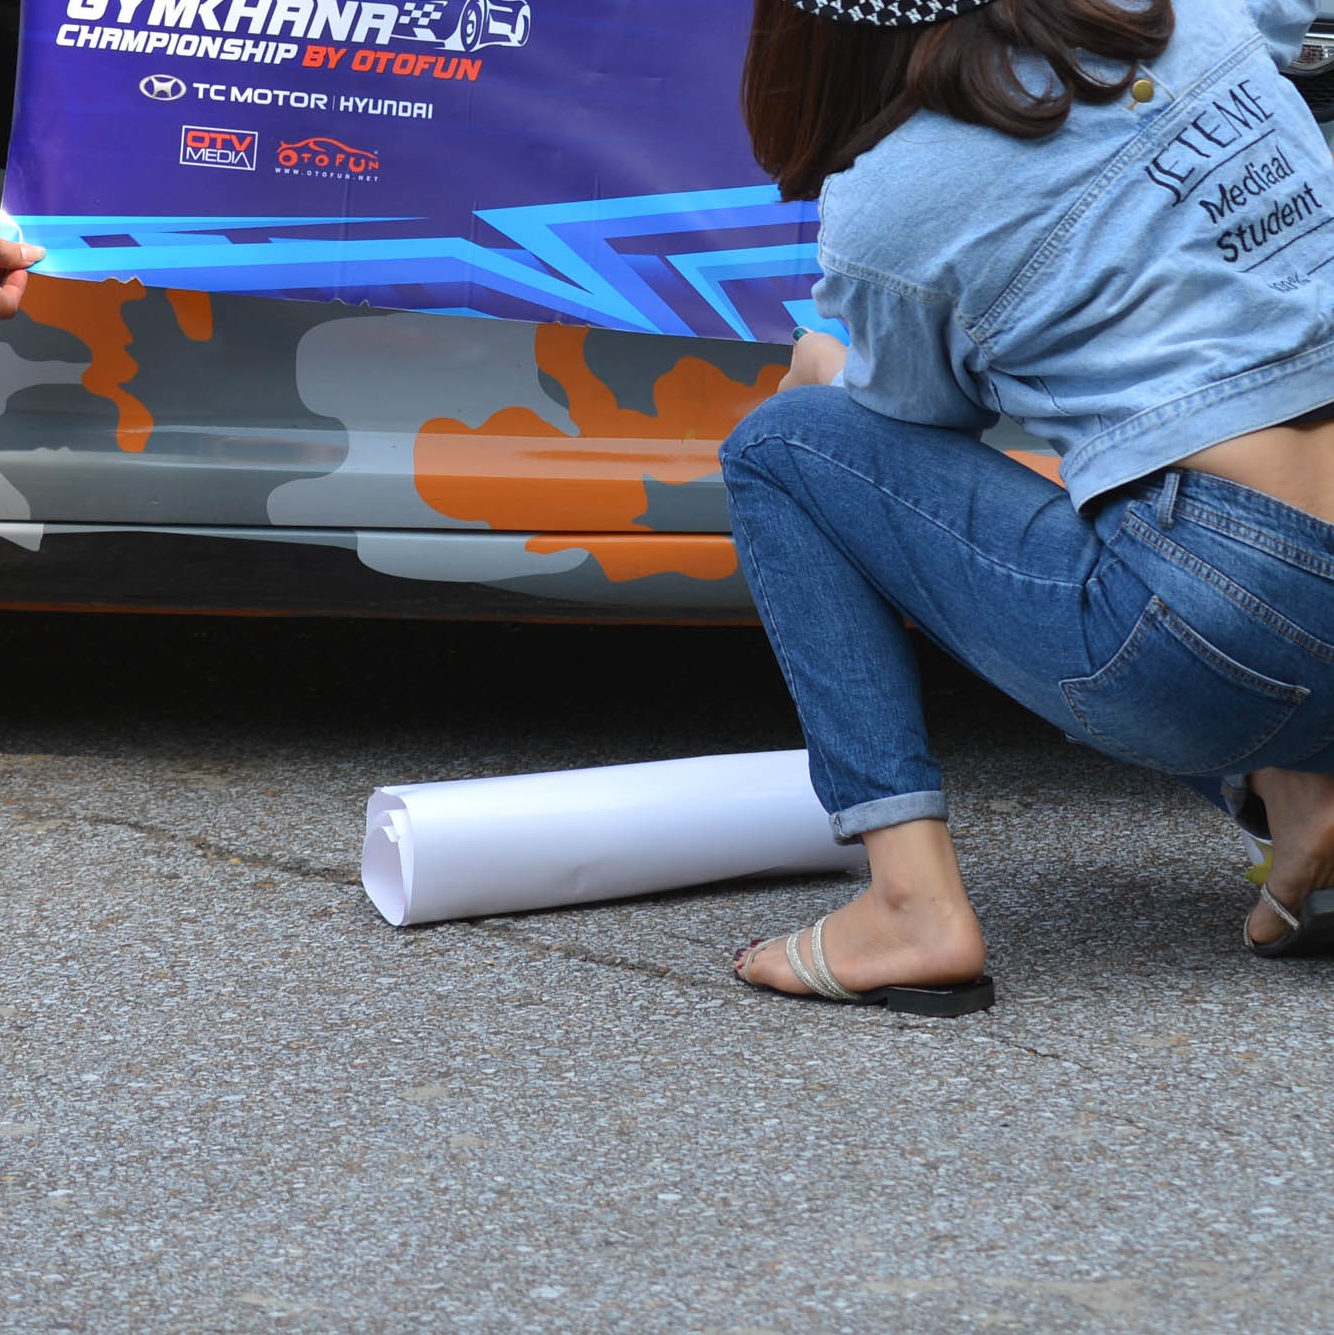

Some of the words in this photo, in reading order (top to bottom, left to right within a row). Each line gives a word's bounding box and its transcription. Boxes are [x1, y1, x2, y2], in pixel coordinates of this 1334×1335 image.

[56, 23, 298, 65] CHAMPIONSHIP
[302, 45, 347, 69] BY
[351, 49, 483, 82] OTOFUN
[193, 82, 226, 102] TC
[230, 86, 327, 110] MOTOR
[339, 96, 434, 119] HYUNDAI
[186, 130, 252, 151] OTV
[186, 146, 252, 169] MEDIA
[278, 149, 379, 173] OTOFUN
